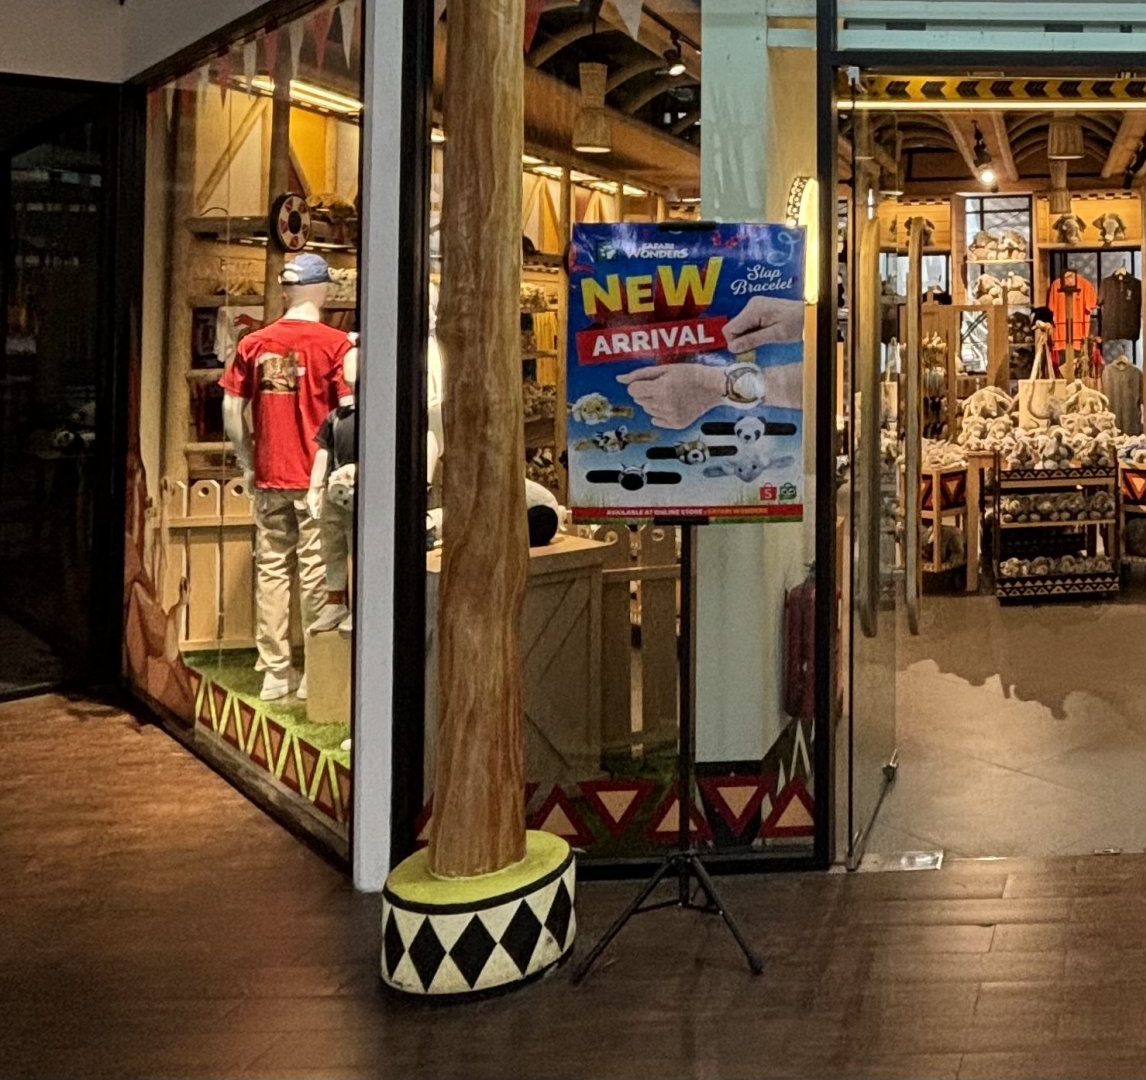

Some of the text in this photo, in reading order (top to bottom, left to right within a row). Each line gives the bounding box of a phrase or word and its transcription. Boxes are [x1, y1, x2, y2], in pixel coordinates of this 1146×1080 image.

[625, 248, 689, 259] WONDERS
[746, 264, 782, 281] Slap
[580, 256, 724, 316] NEW
[730, 276, 794, 296] Bracelet
[592, 323, 716, 358] ARRIVAL
